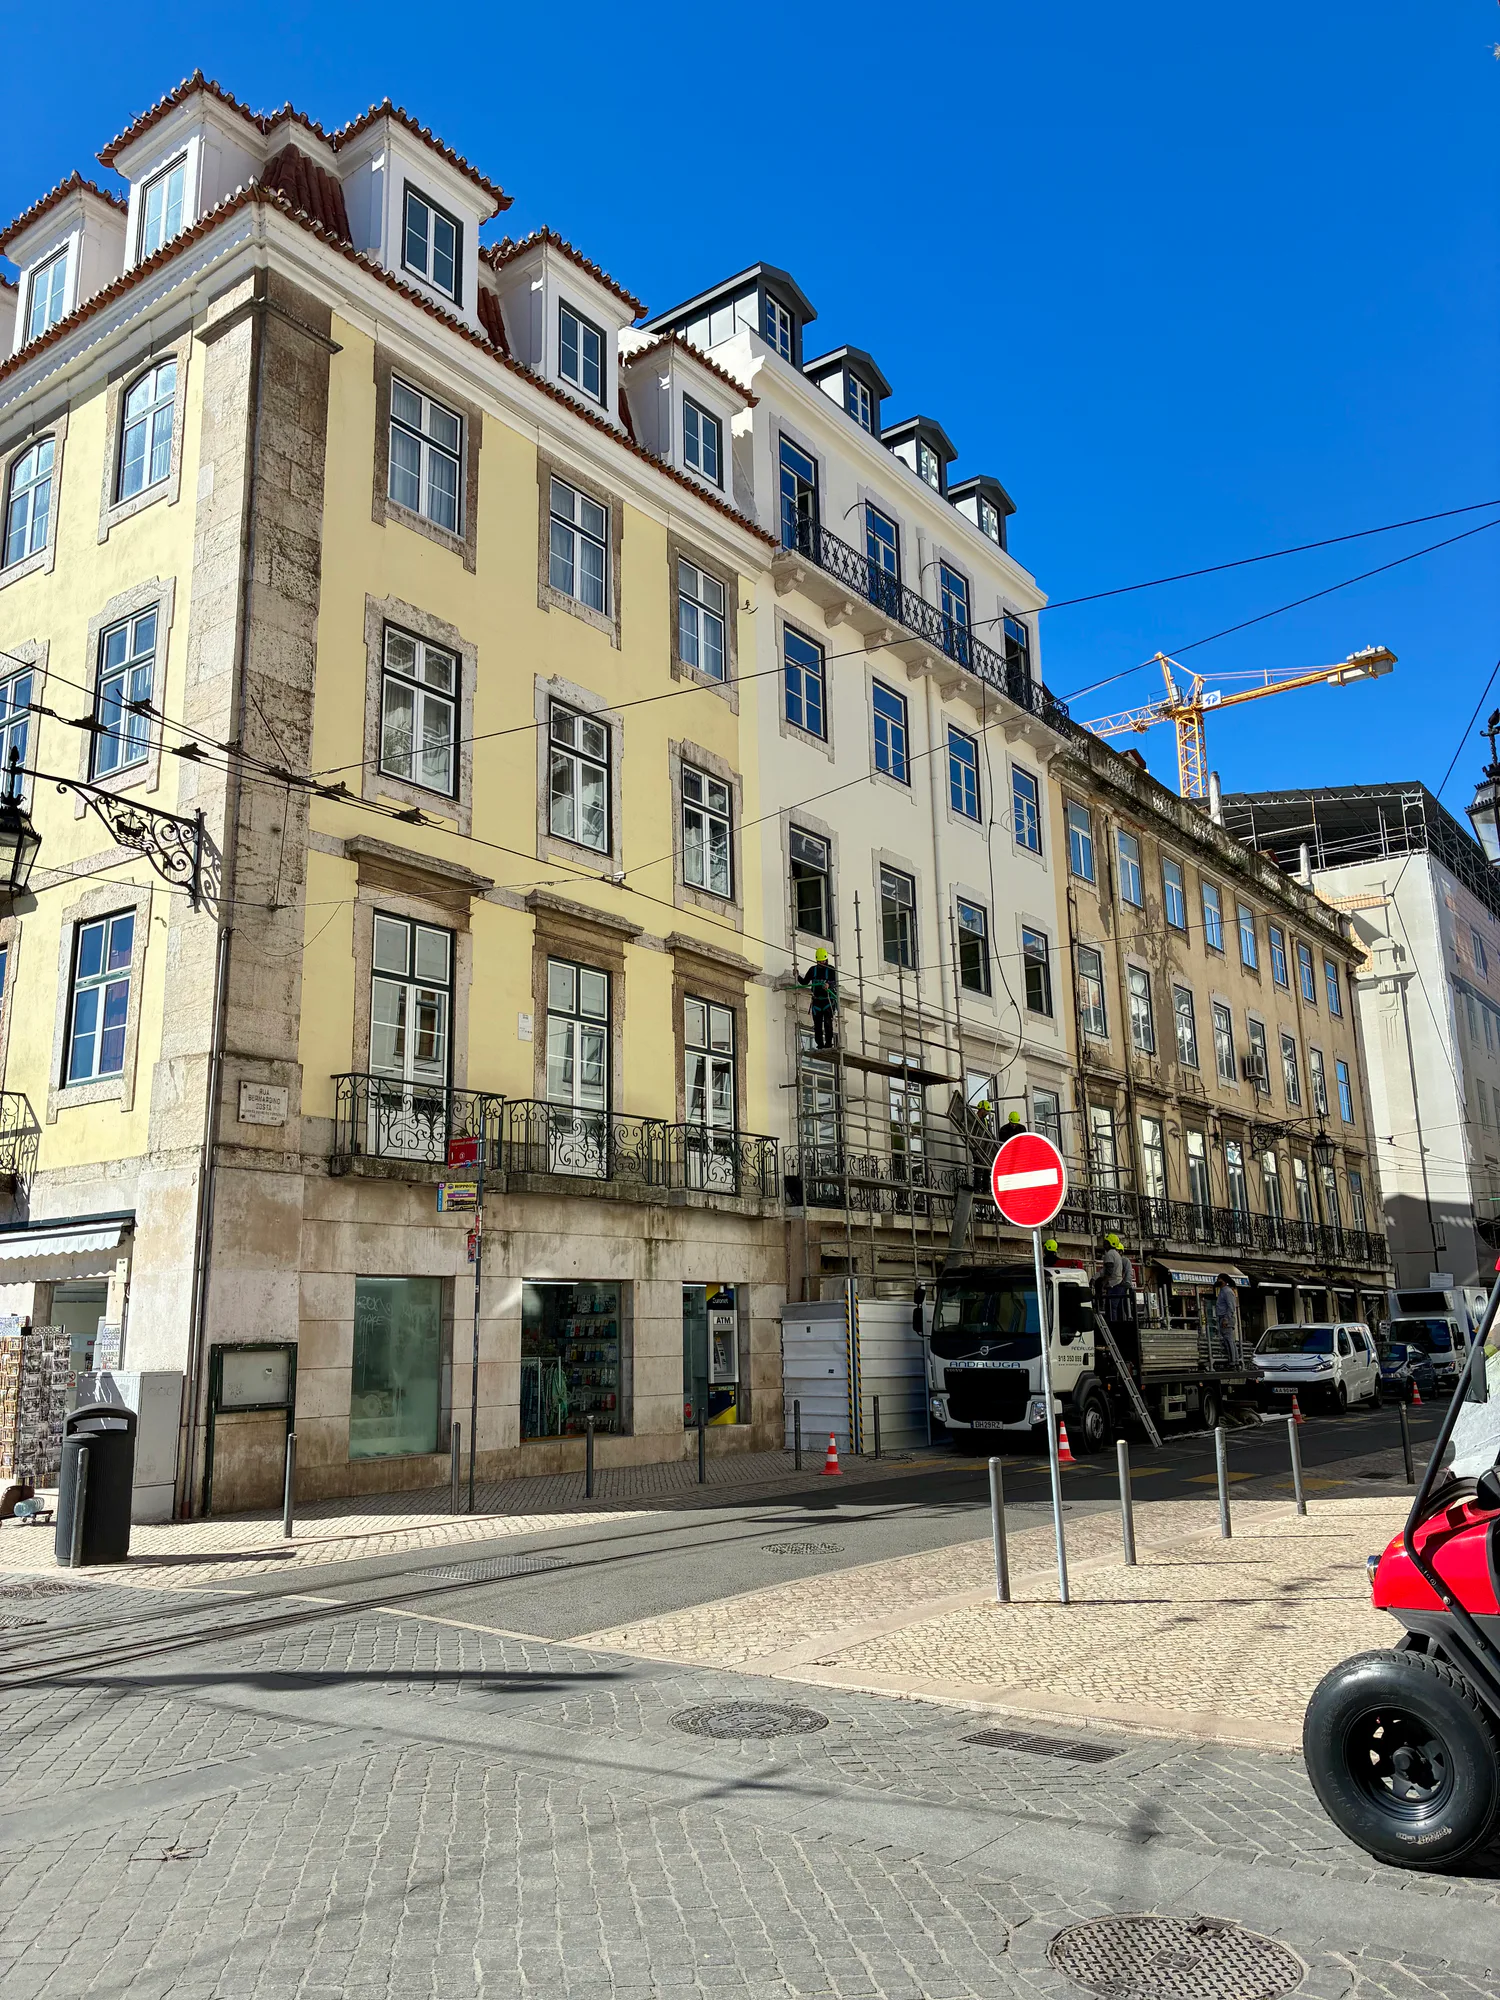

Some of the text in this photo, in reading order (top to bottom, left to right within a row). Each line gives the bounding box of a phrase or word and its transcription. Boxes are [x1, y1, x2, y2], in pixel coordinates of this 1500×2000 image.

[259, 1088, 270, 1096] RUA
[248, 1094, 281, 1105] BERNARDINO
[255, 1103, 272, 1111] COSTA
[1179, 1273, 1214, 1283] SUPERMARKET
[716, 1316, 731, 1324] ATM
